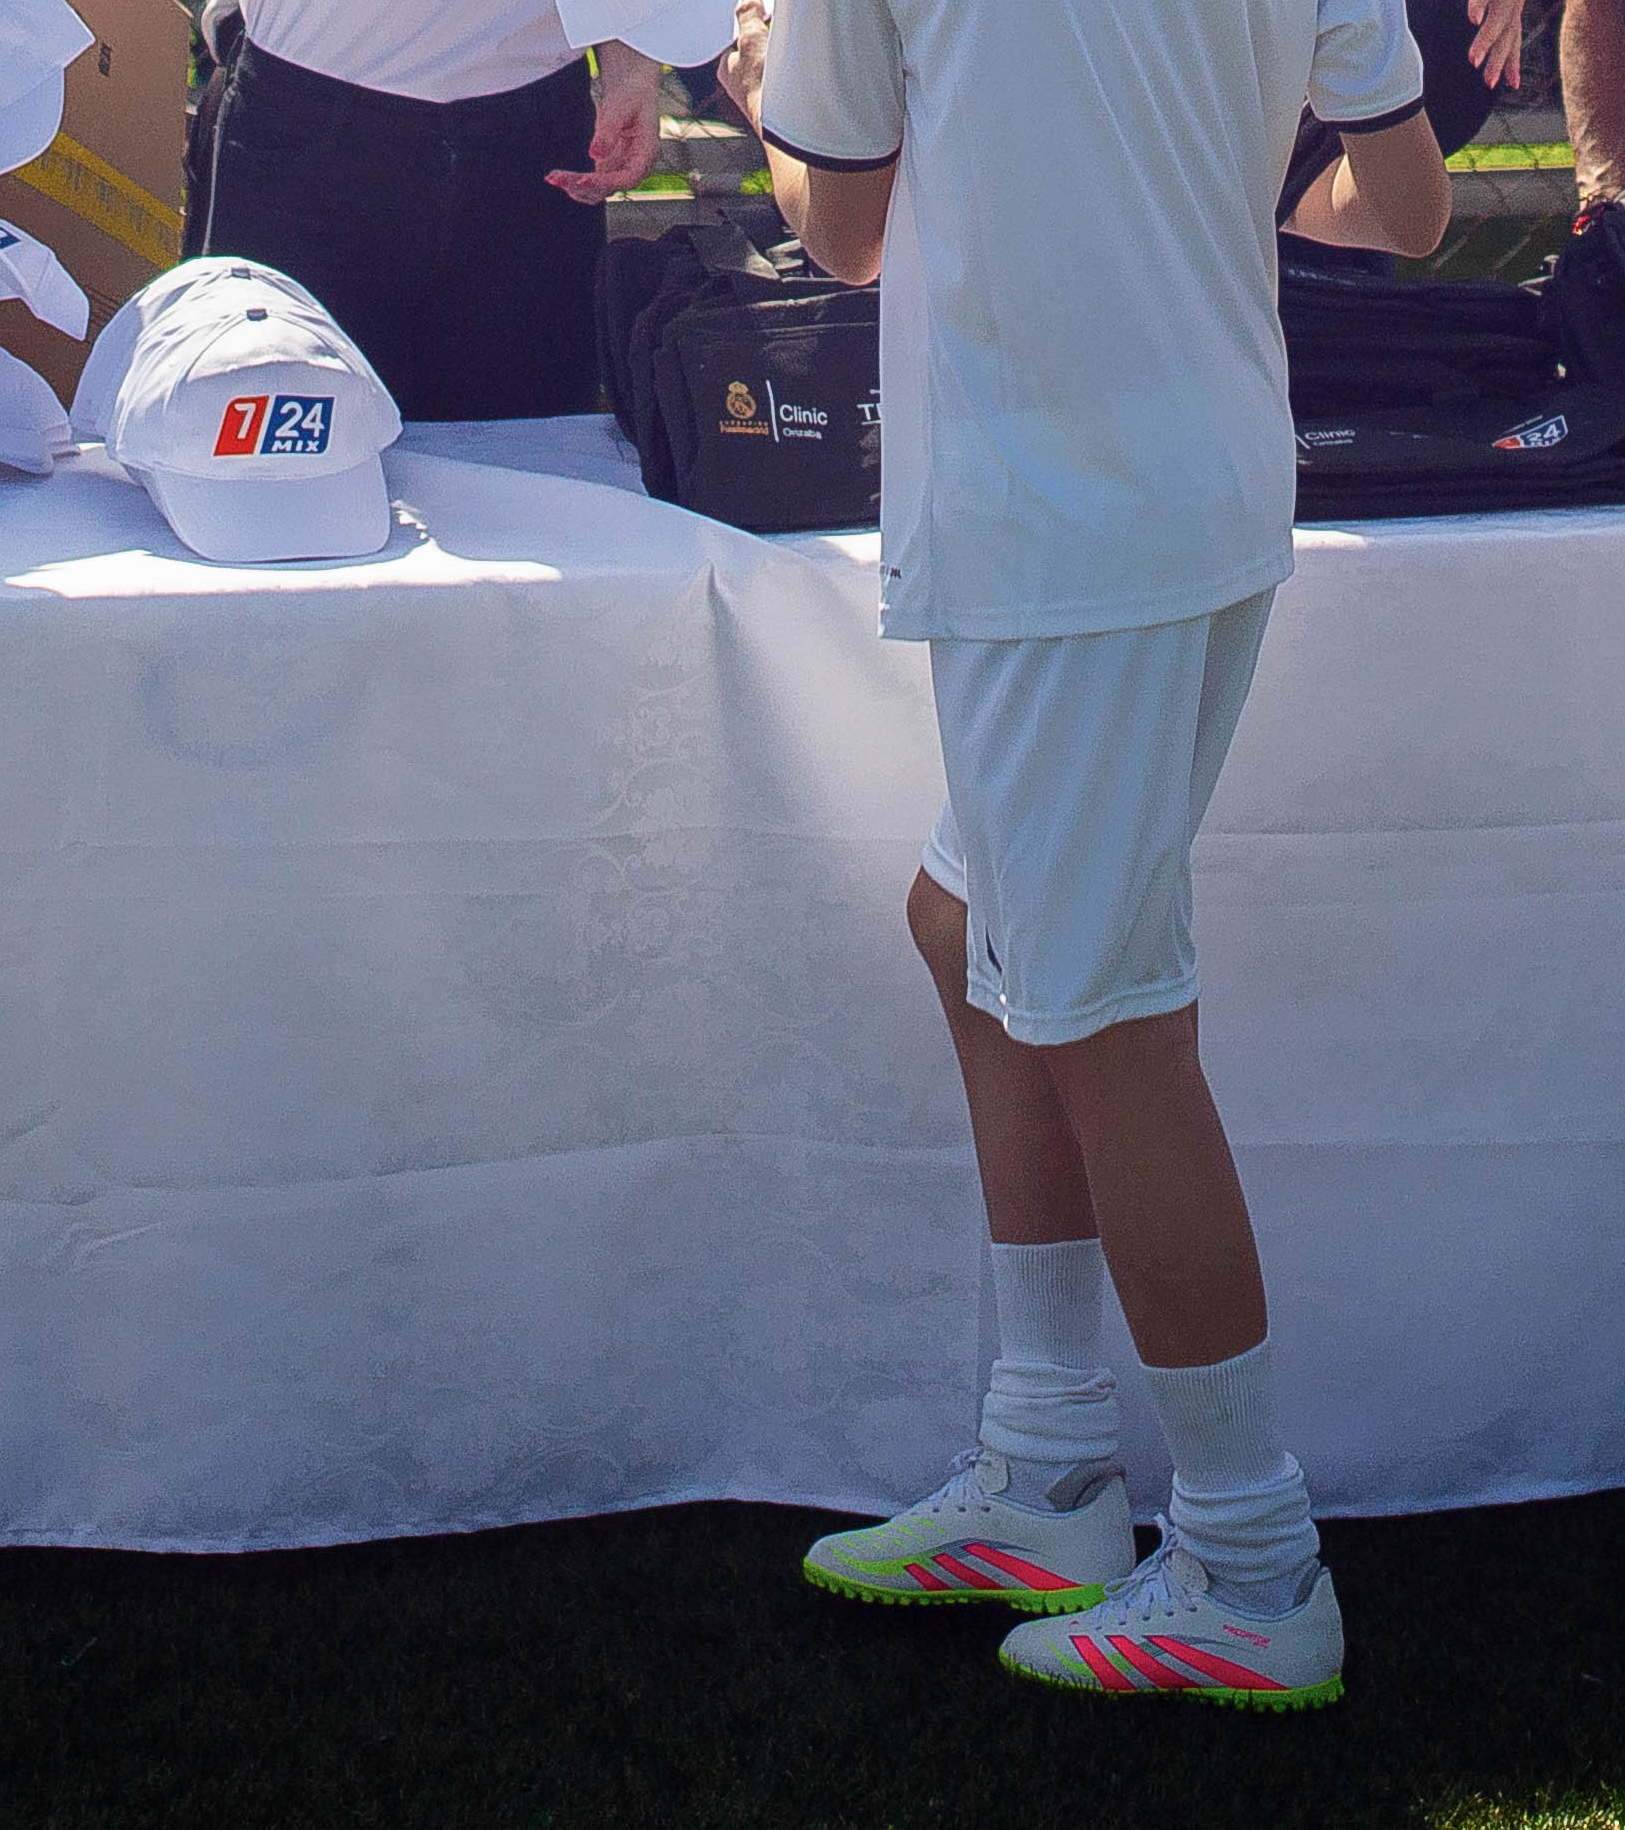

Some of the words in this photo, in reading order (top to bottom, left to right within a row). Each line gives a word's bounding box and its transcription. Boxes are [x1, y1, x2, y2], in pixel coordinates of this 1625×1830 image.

[274, 401, 325, 438] 24
[779, 404, 829, 425] Clinic
[270, 440, 321, 452] MIX
